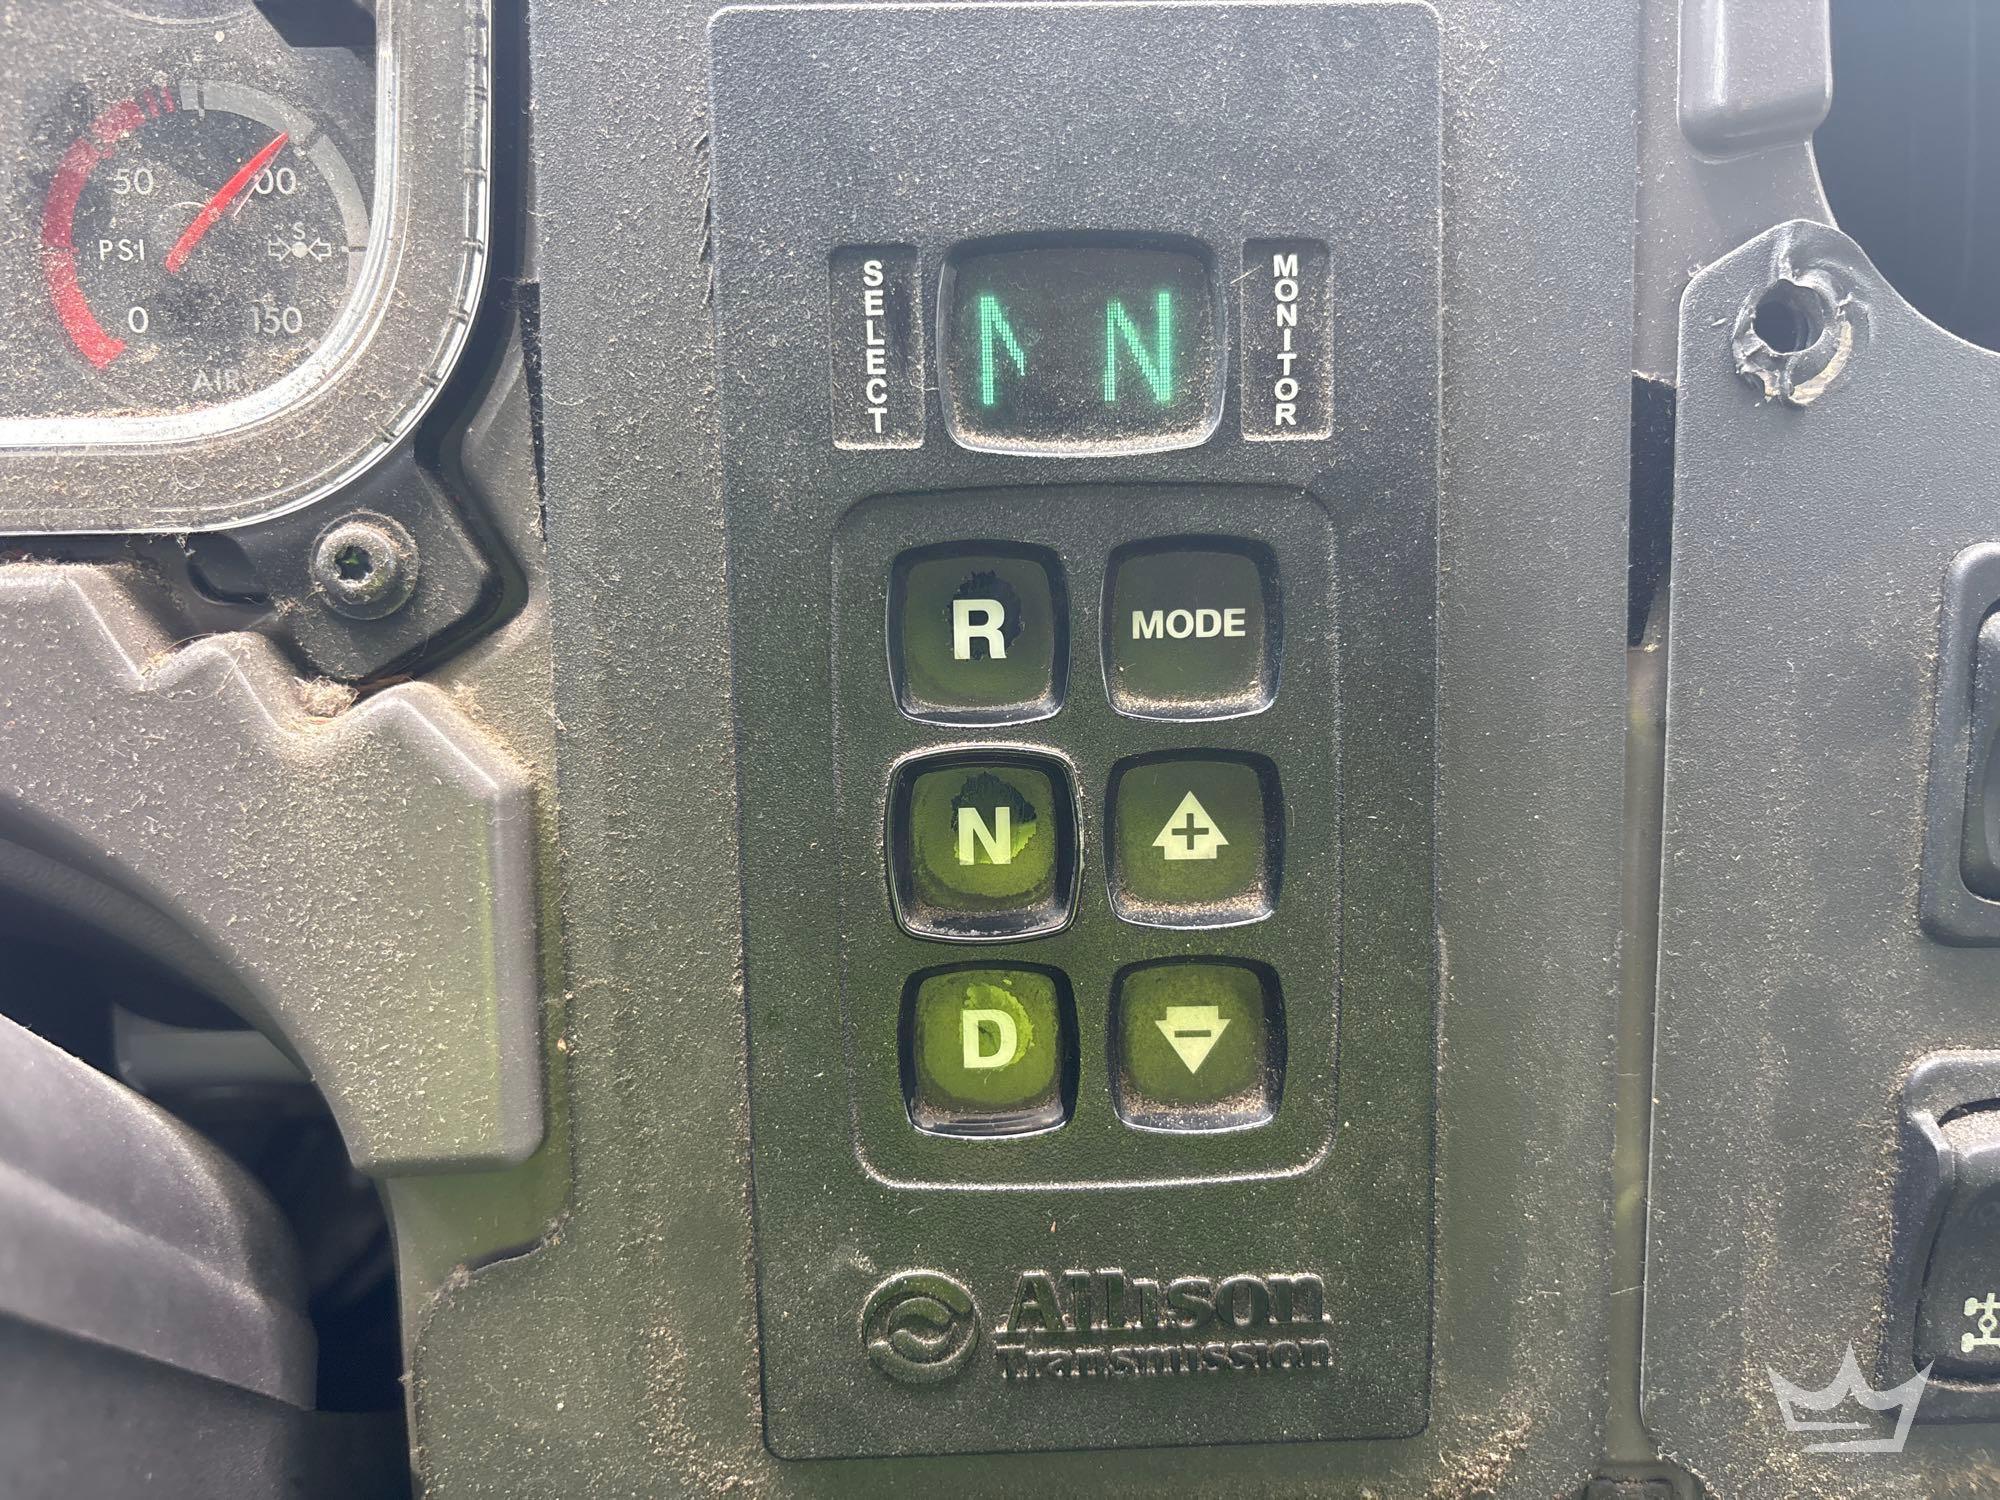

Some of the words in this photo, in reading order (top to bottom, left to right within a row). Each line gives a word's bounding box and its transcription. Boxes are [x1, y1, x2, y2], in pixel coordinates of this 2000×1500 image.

[113, 167, 154, 195] 50
[249, 167, 297, 195] 00
[99, 239, 145, 262] PSI
[127, 306, 149, 334] 0
[252, 306, 303, 334] 150
[1273, 254, 1299, 427] MONITOR
[863, 260, 888, 434] SELECT
[1104, 292, 1173, 403] N
[191, 368, 240, 393] AIR
[952, 599, 1008, 660] R
[1132, 607, 1246, 640] MODE
[958, 806, 1011, 866] N
[962, 1008, 1018, 1069] D
[996, 1268, 1331, 1332] Allison
[996, 1338, 1333, 1379] Transmission
